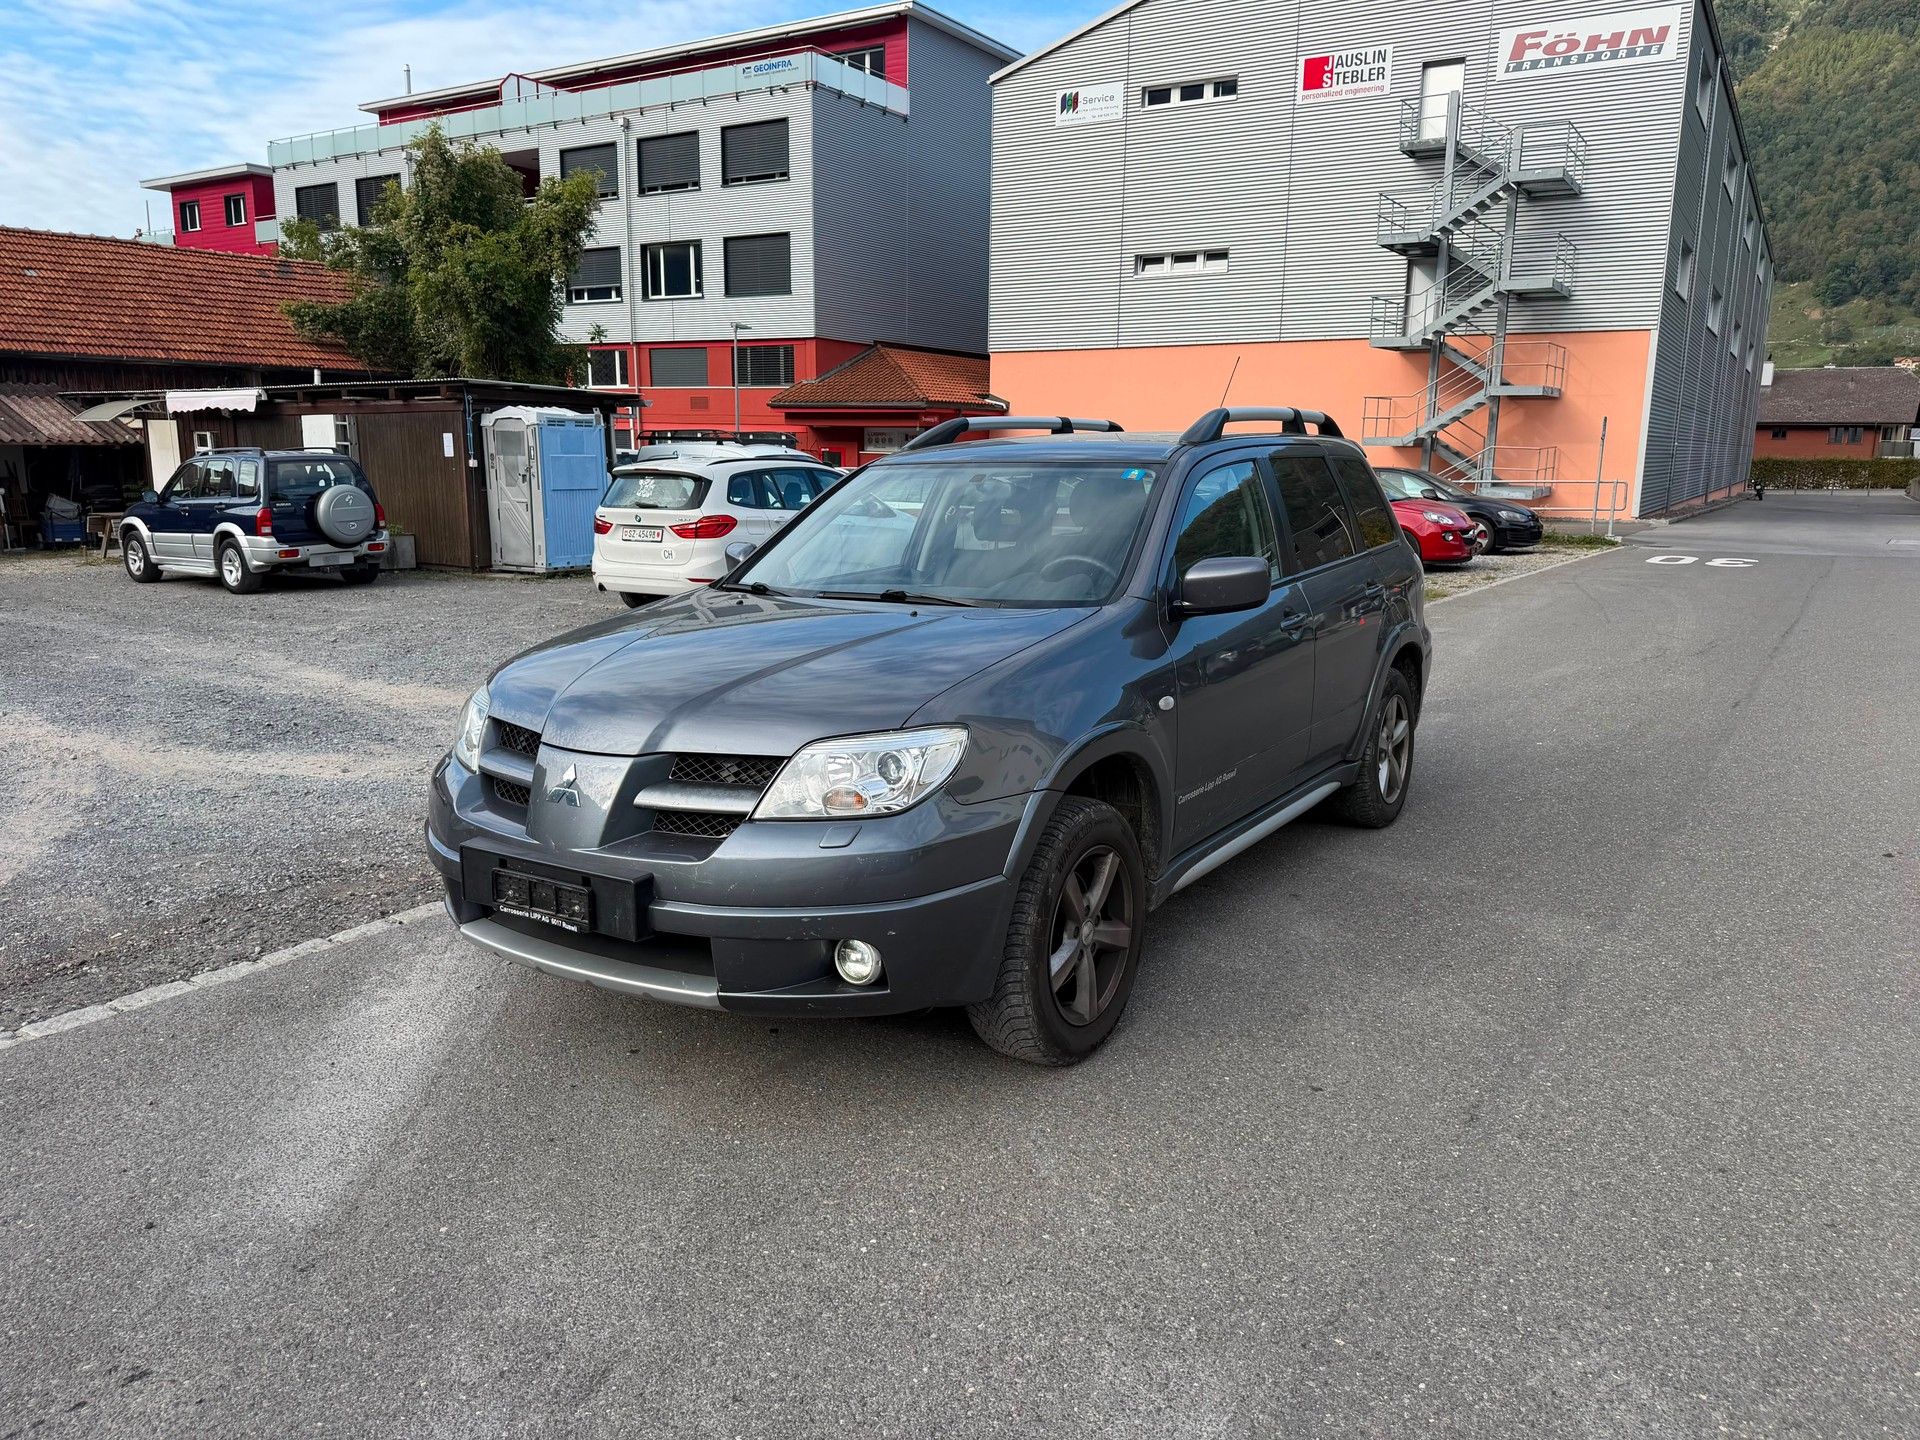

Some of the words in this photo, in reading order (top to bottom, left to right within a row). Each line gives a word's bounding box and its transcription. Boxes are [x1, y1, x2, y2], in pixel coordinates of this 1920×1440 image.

[1508, 25, 1671, 61] FÖHN
[753, 59, 793, 73] GEOINFRA
[1324, 49, 1387, 71] JAUSLIN
[1508, 44, 1660, 71] TRANSPORTE
[1322, 66, 1386, 88] STEBLER
[1301, 89, 1343, 102] personalized
[1344, 84, 1385, 96] engineering
[663, 549, 674, 560] CH
[500, 904, 529, 918] Carrosserie
[529, 911, 542, 921] LIPP
[541, 914, 550, 924] AG
